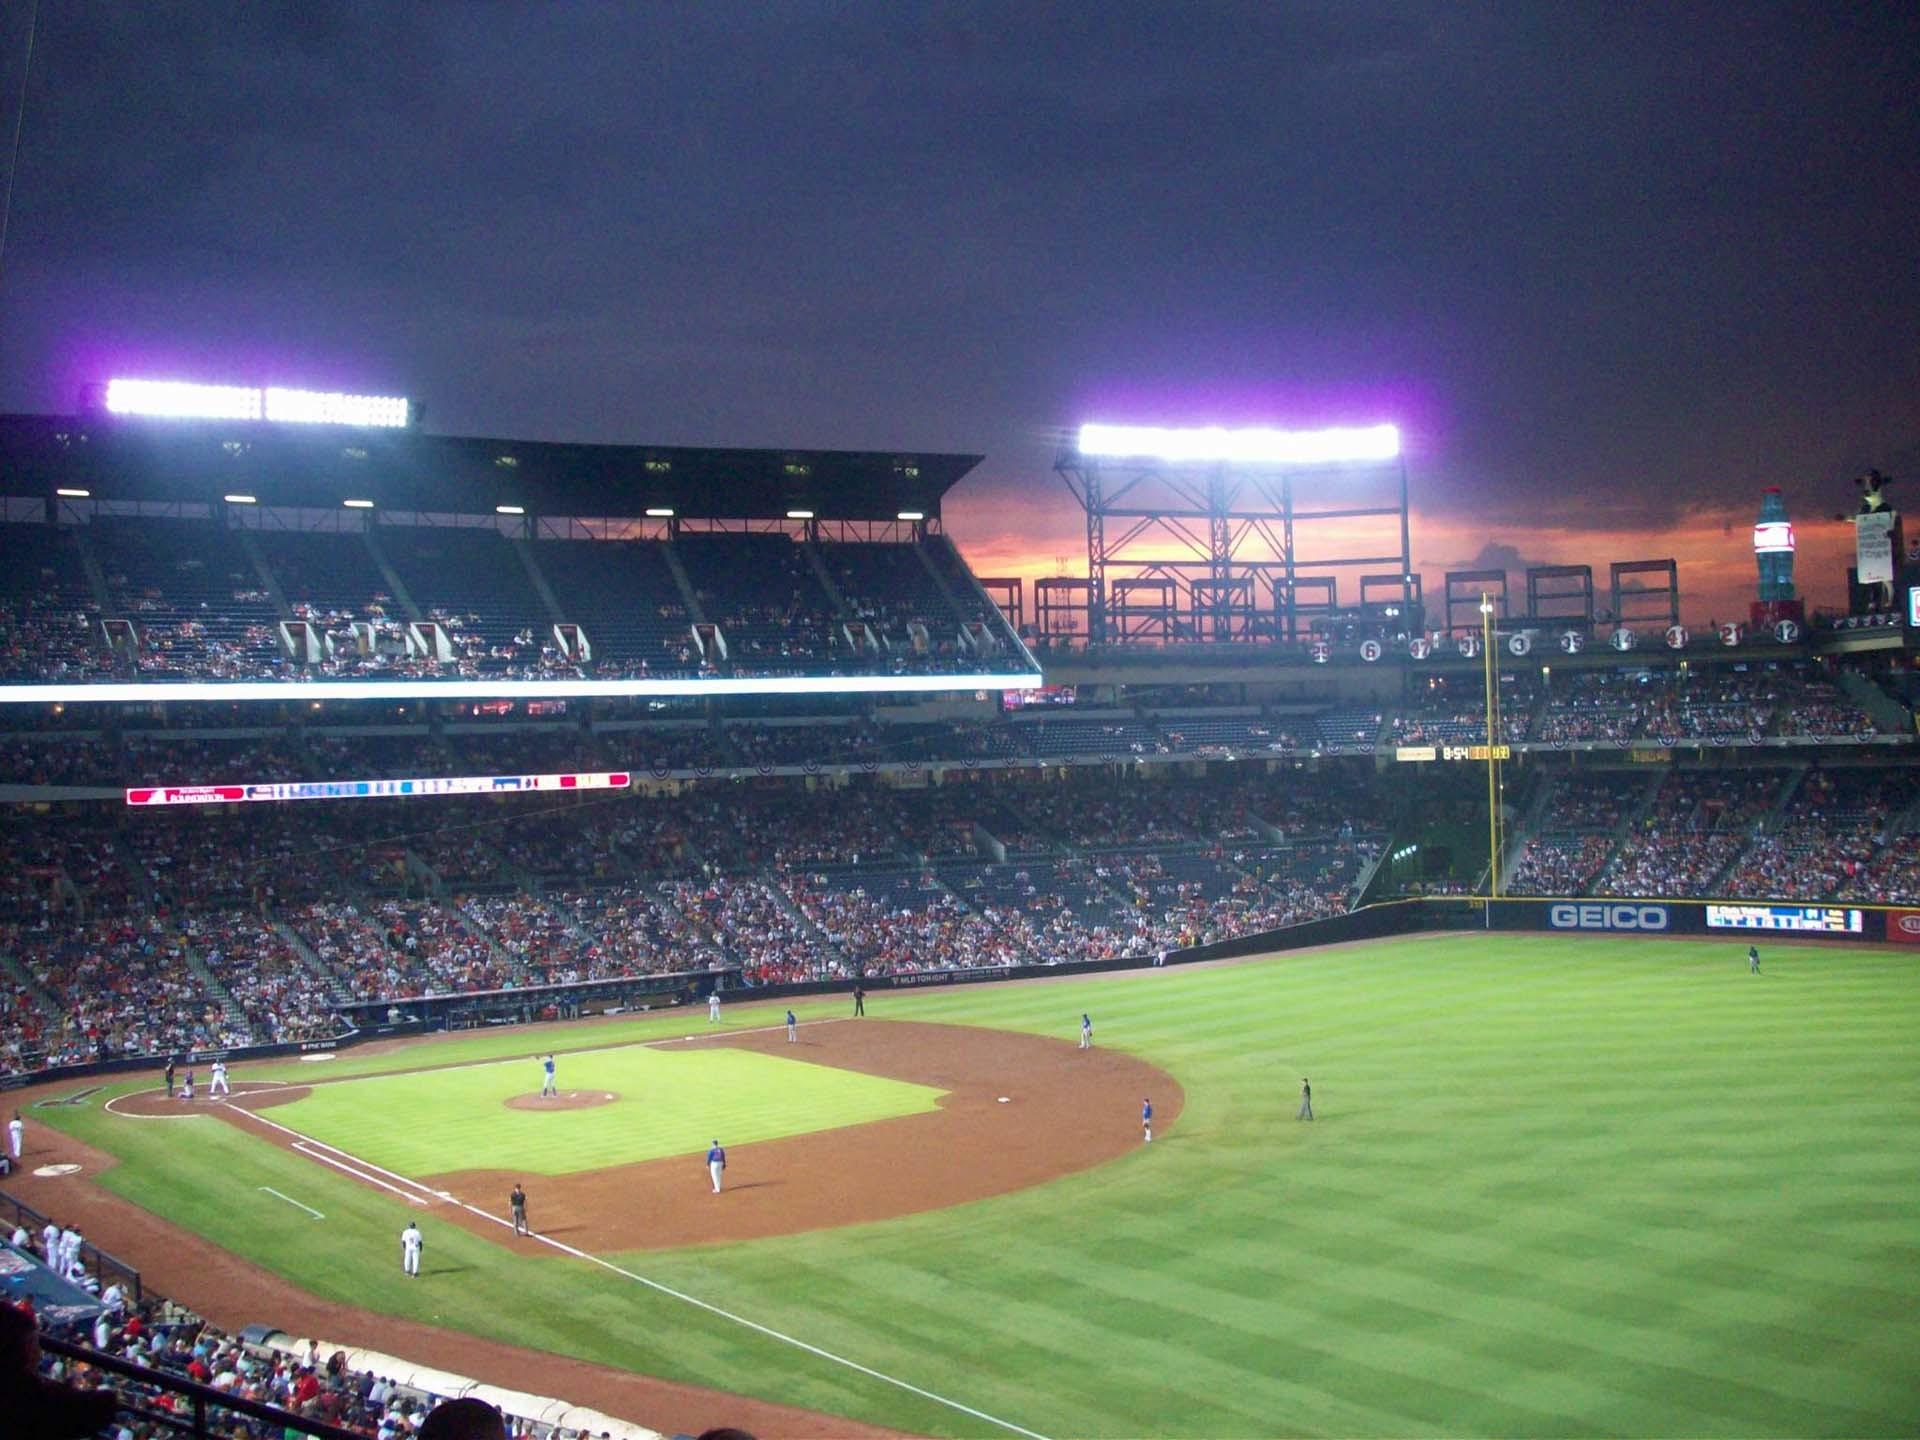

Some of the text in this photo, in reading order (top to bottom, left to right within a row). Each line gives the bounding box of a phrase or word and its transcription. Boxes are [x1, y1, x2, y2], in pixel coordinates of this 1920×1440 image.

[1667, 629, 1687, 646] 41
[1721, 627, 1742, 642] 21
[1443, 747, 1468, 760] 8:54
[1551, 905, 1667, 929] GEICO
